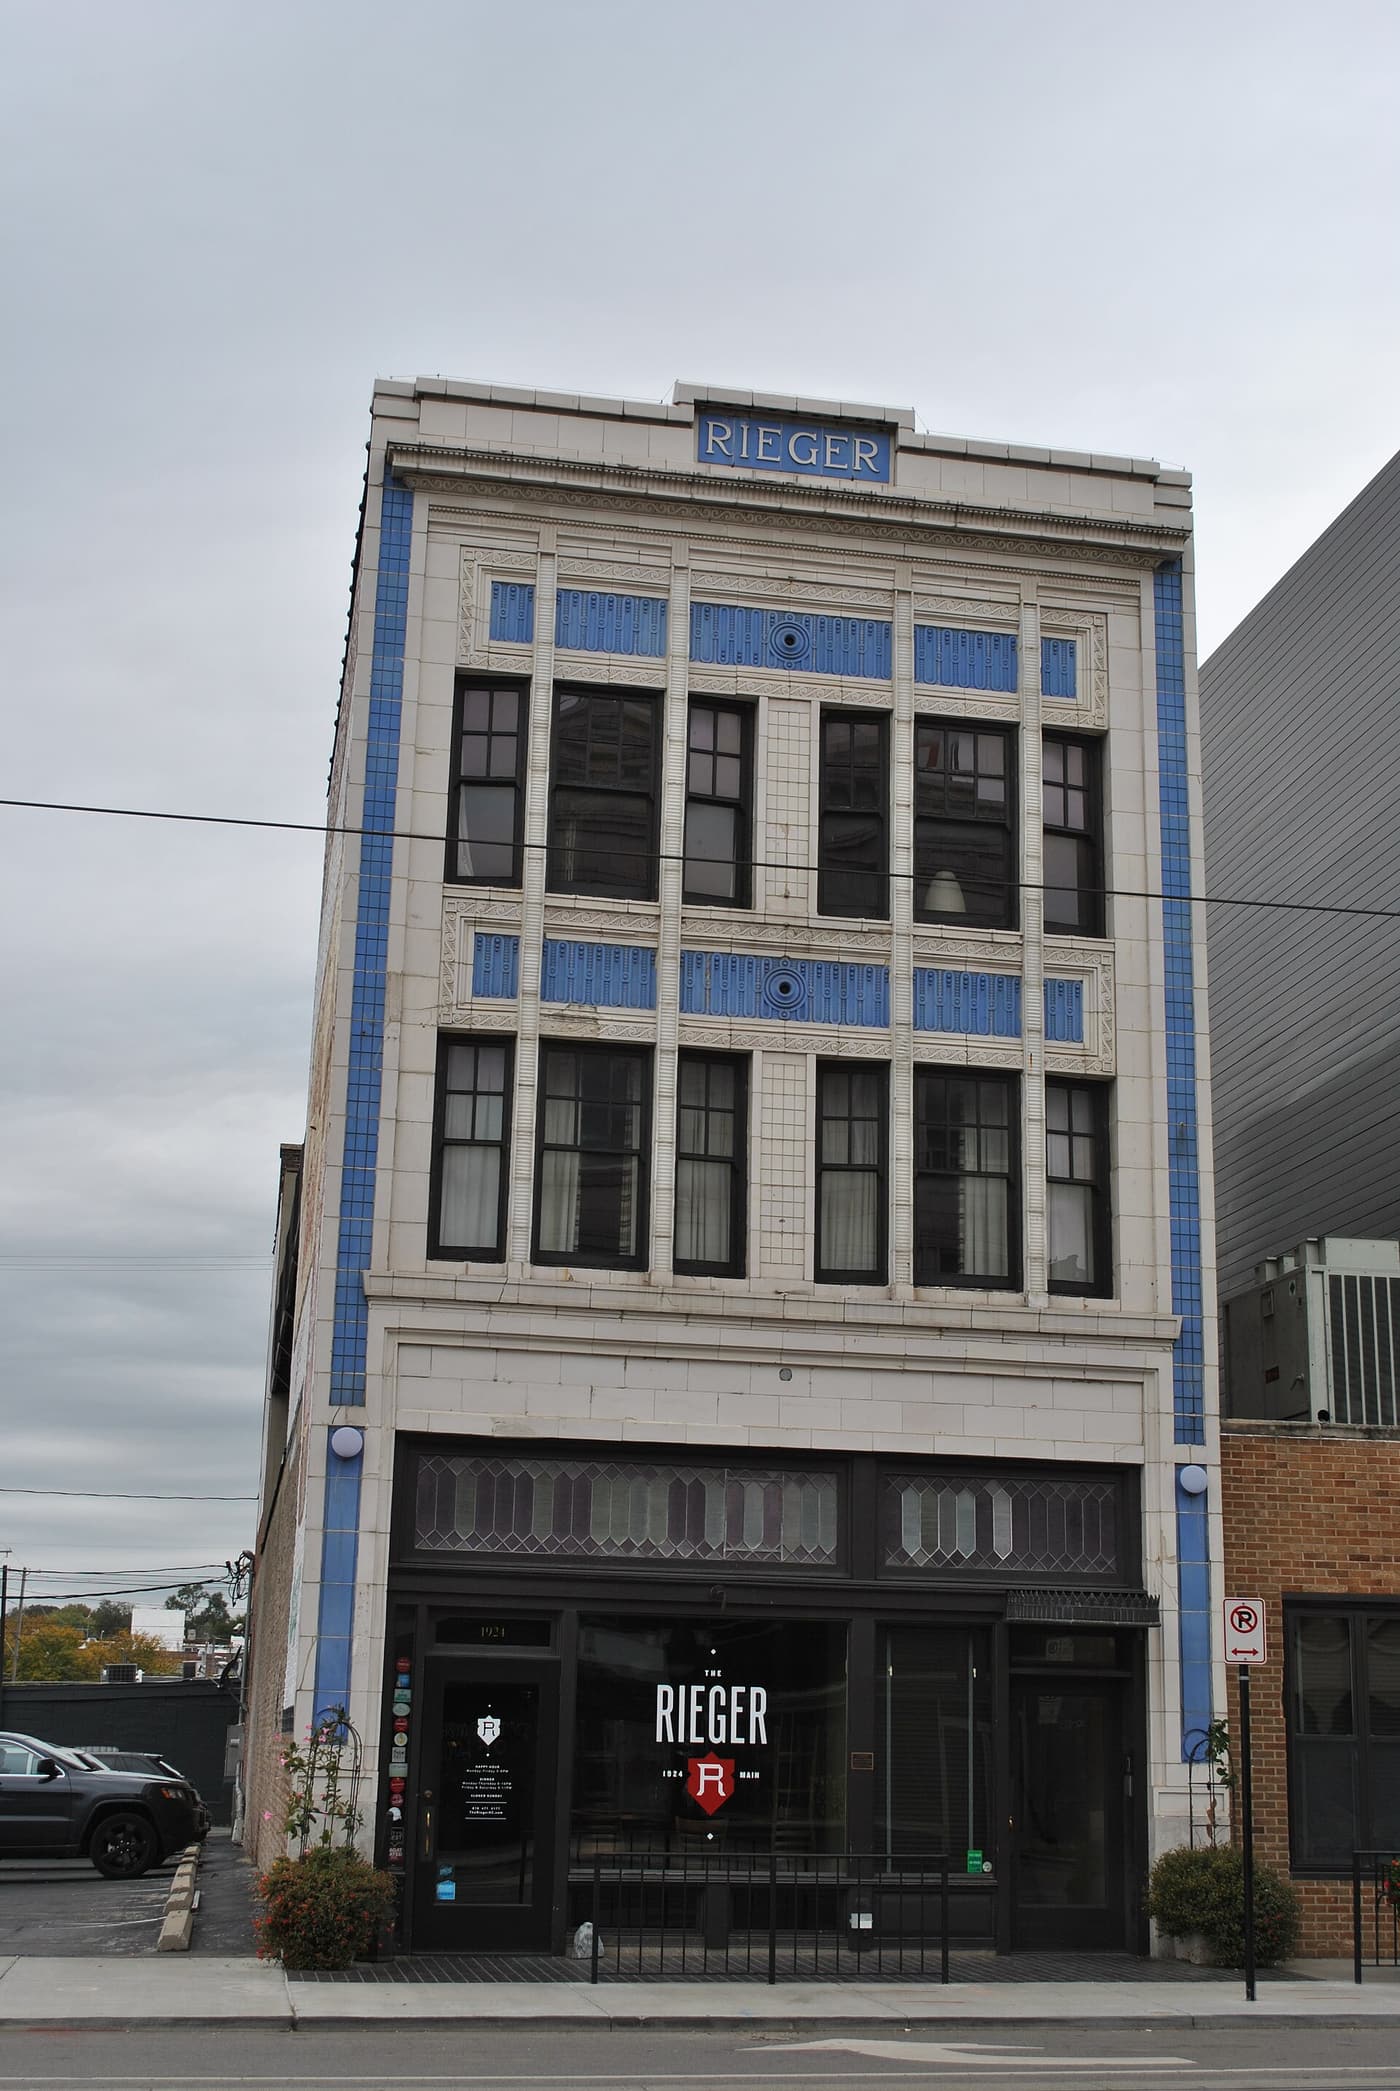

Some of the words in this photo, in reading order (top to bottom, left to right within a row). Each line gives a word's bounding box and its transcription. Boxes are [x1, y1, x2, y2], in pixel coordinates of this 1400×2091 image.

[705, 420, 880, 474] RIEGER
[1238, 1611, 1252, 1629] P
[704, 1669, 722, 1678] THE
[656, 1684, 768, 1745] RIEGER
[483, 1721, 496, 1737] R
[696, 1763, 726, 1797] R
[739, 1771, 760, 1779] MAIN
